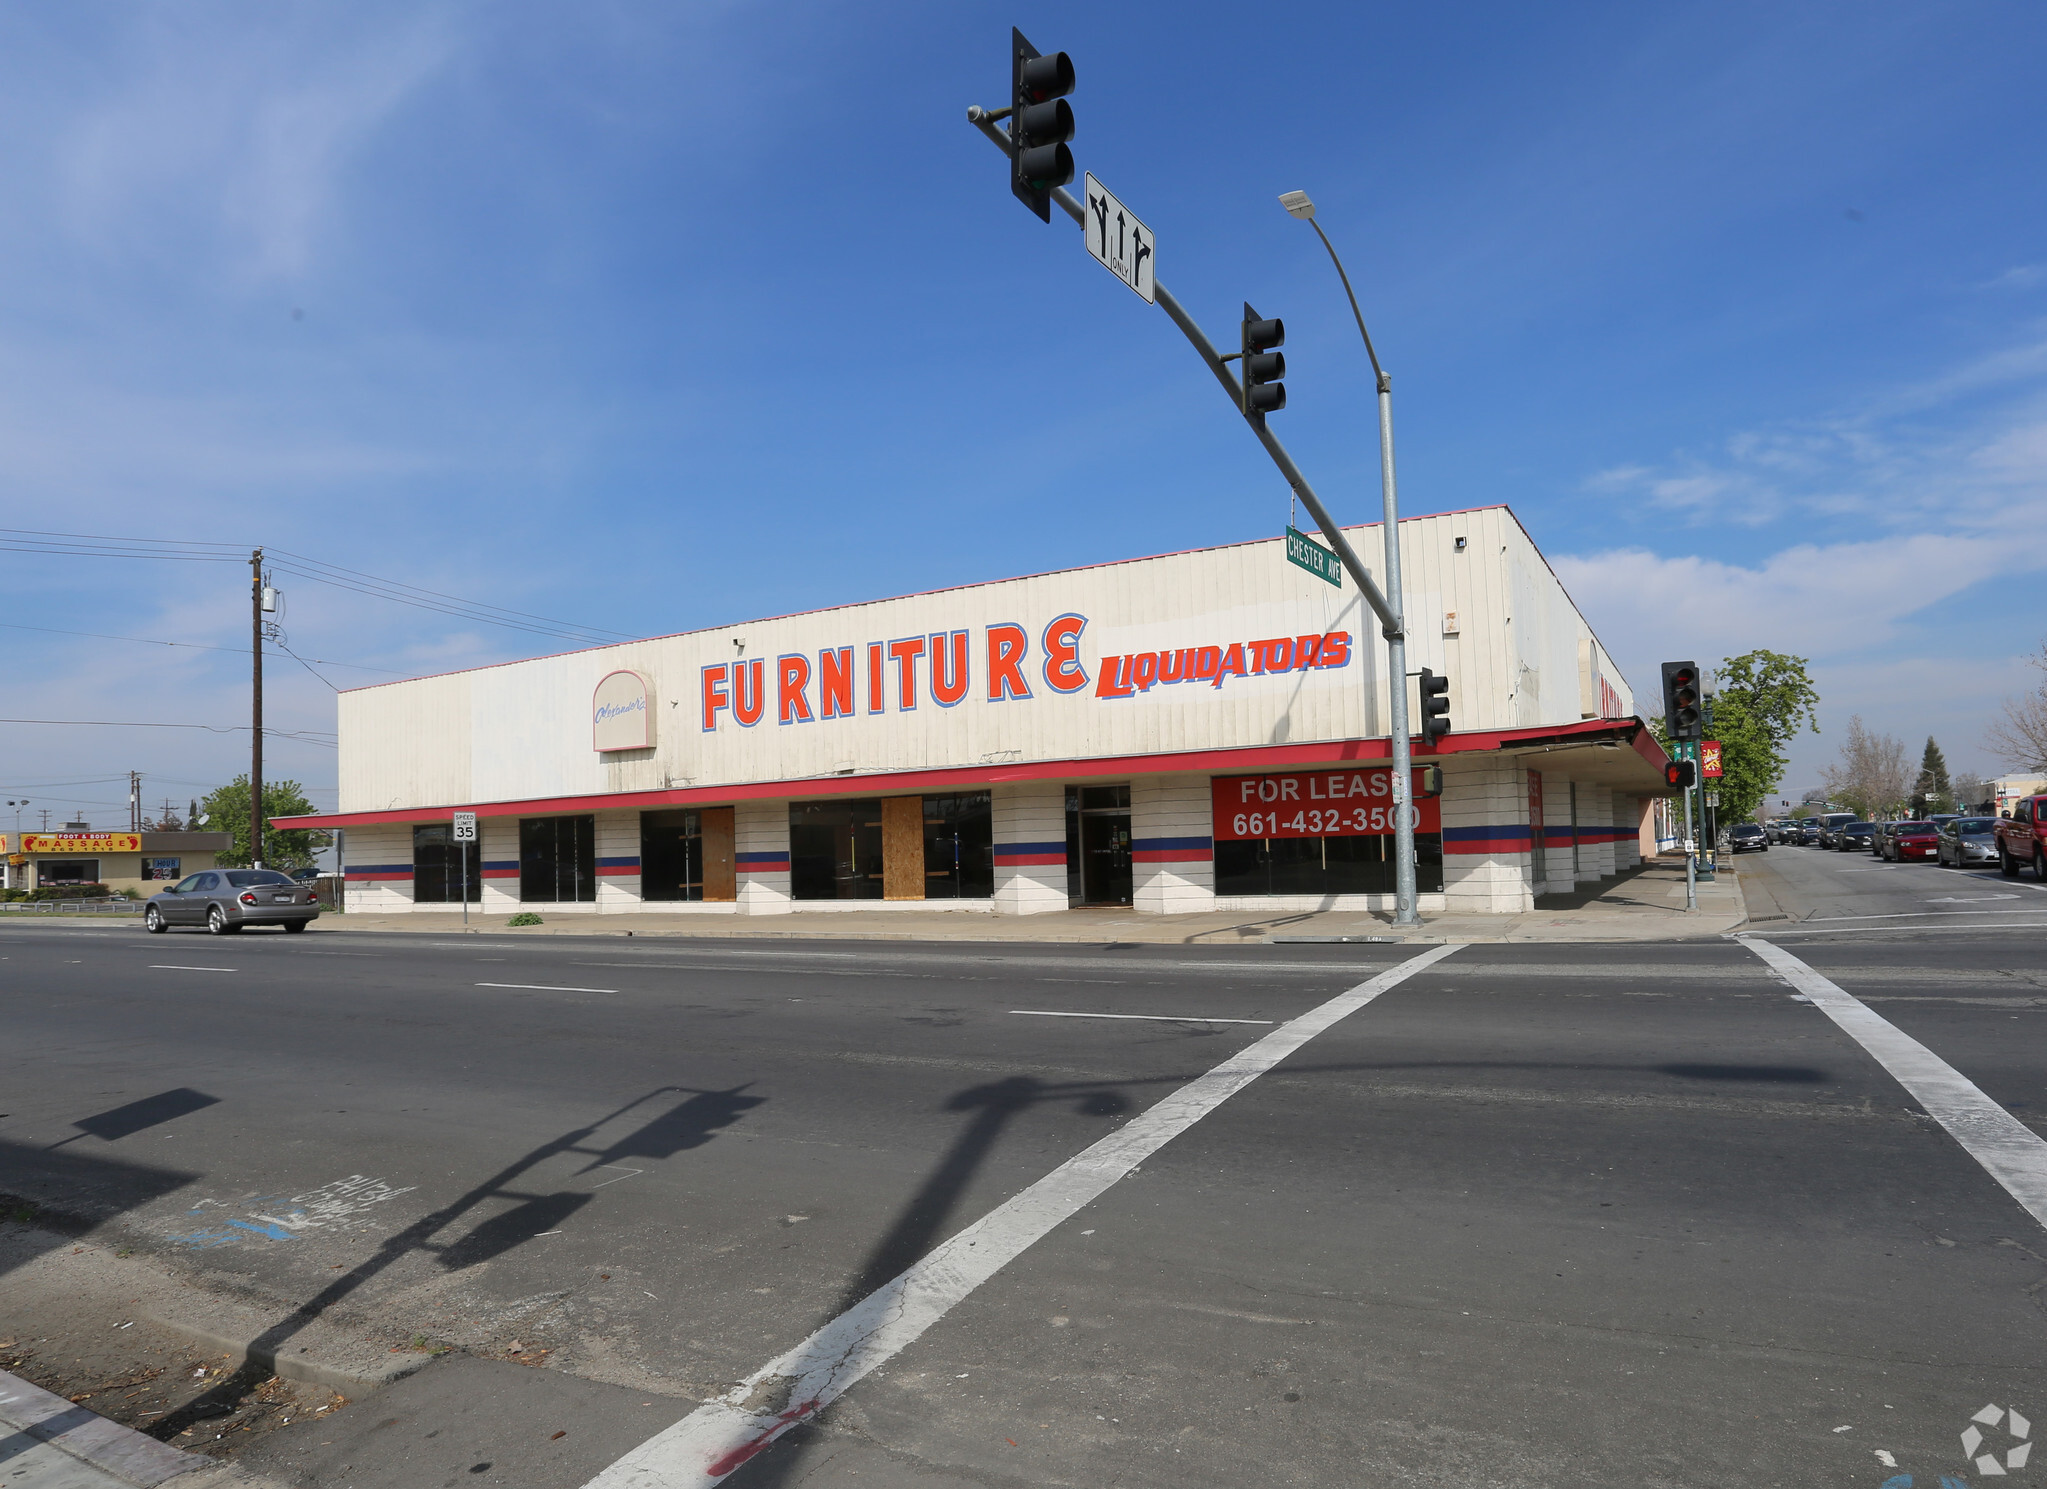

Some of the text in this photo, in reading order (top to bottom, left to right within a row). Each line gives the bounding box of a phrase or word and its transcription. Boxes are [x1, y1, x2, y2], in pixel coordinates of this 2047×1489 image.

[1112, 257, 1129, 278] ONLY
[1288, 535, 1341, 582] CHESTER AVE
[701, 612, 1353, 733] FURNITURE LIQUIDATORS
[1241, 778, 1300, 803] FOR
[1310, 773, 1389, 800] LEAS
[456, 826, 474, 838] 35
[157, 859, 176, 867] HOUR
